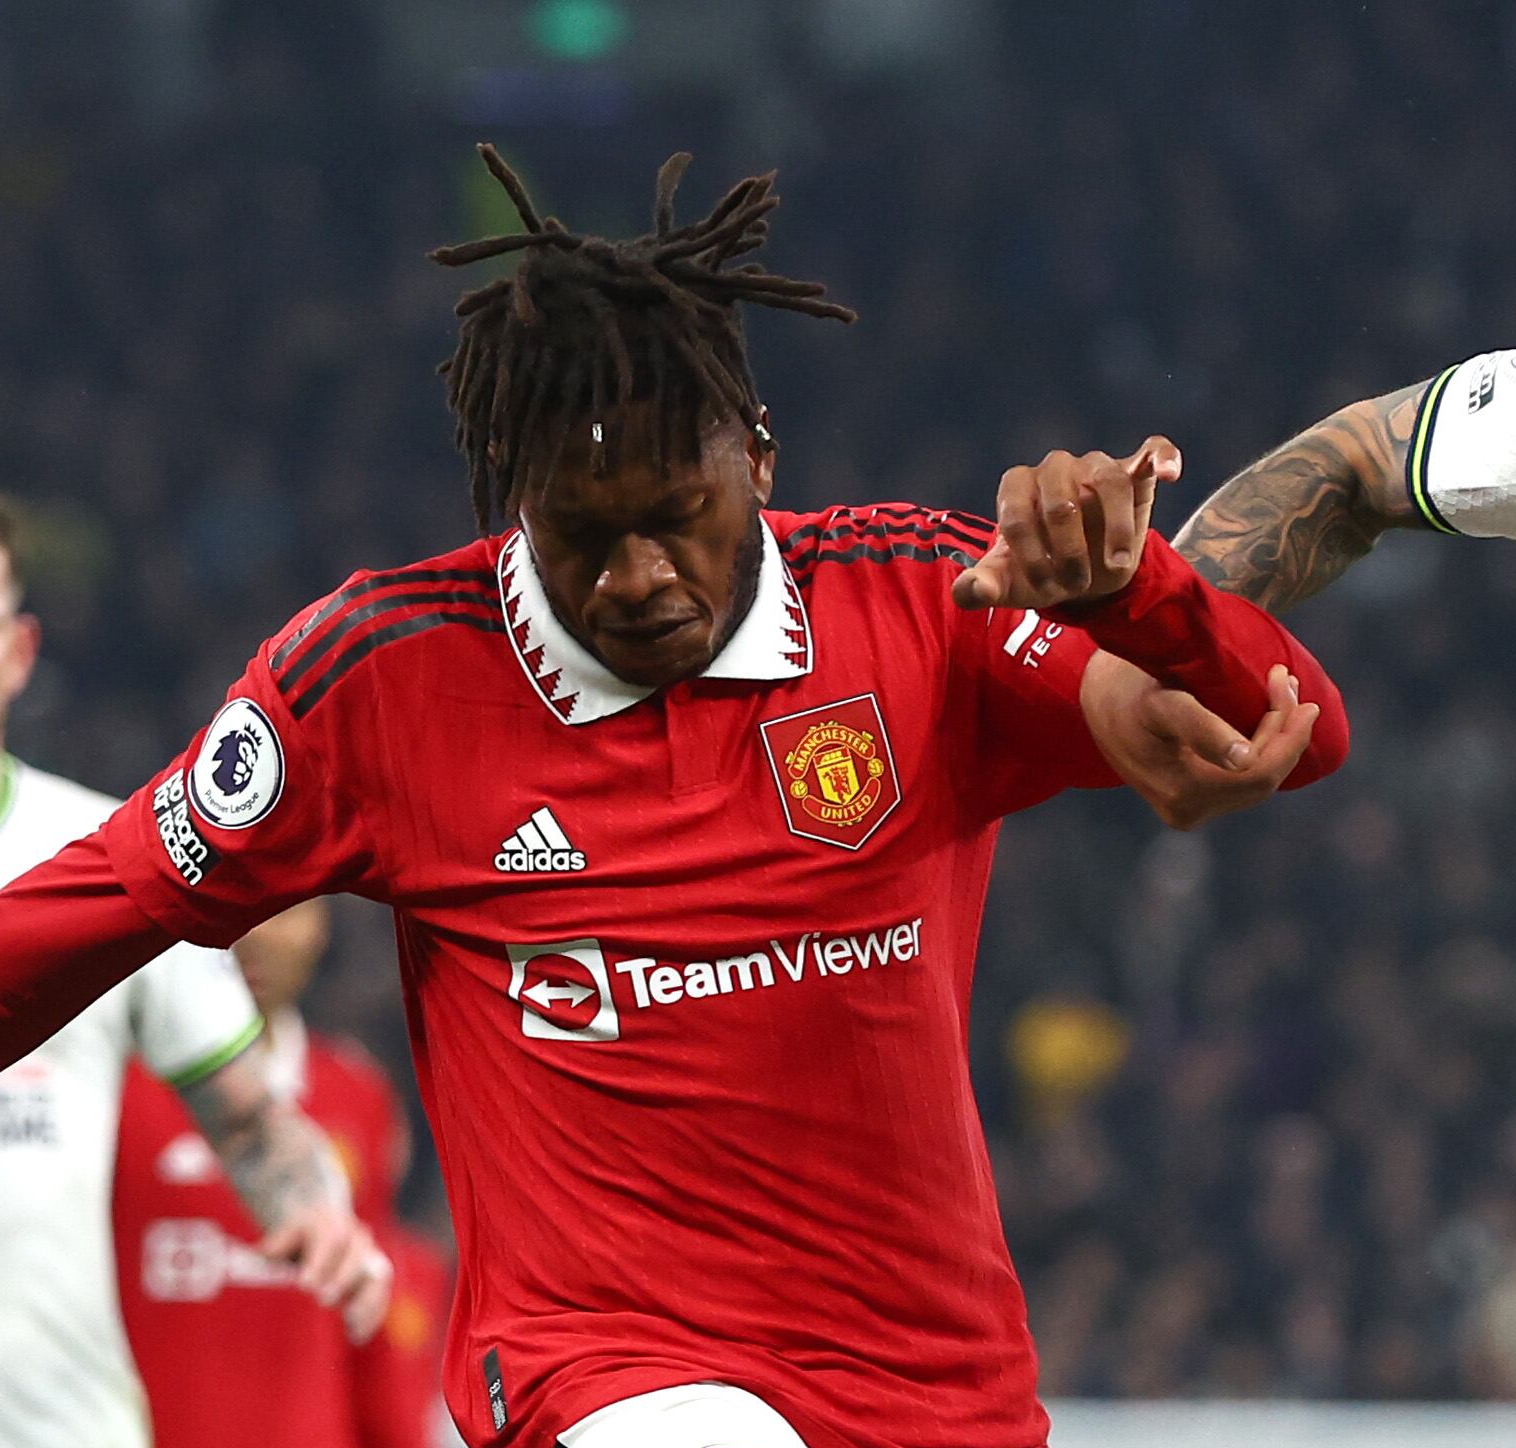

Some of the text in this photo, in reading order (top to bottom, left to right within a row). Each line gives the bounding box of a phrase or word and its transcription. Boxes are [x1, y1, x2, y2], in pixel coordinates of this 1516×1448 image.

[794, 729, 869, 771] MANCHESTER
[204, 789, 259, 814] Premier League
[821, 794, 872, 819] UNITED
[157, 809, 203, 886] racism
[173, 799, 208, 863] room
[494, 848, 586, 872] adidas
[614, 917, 922, 1009] TeamViewer
